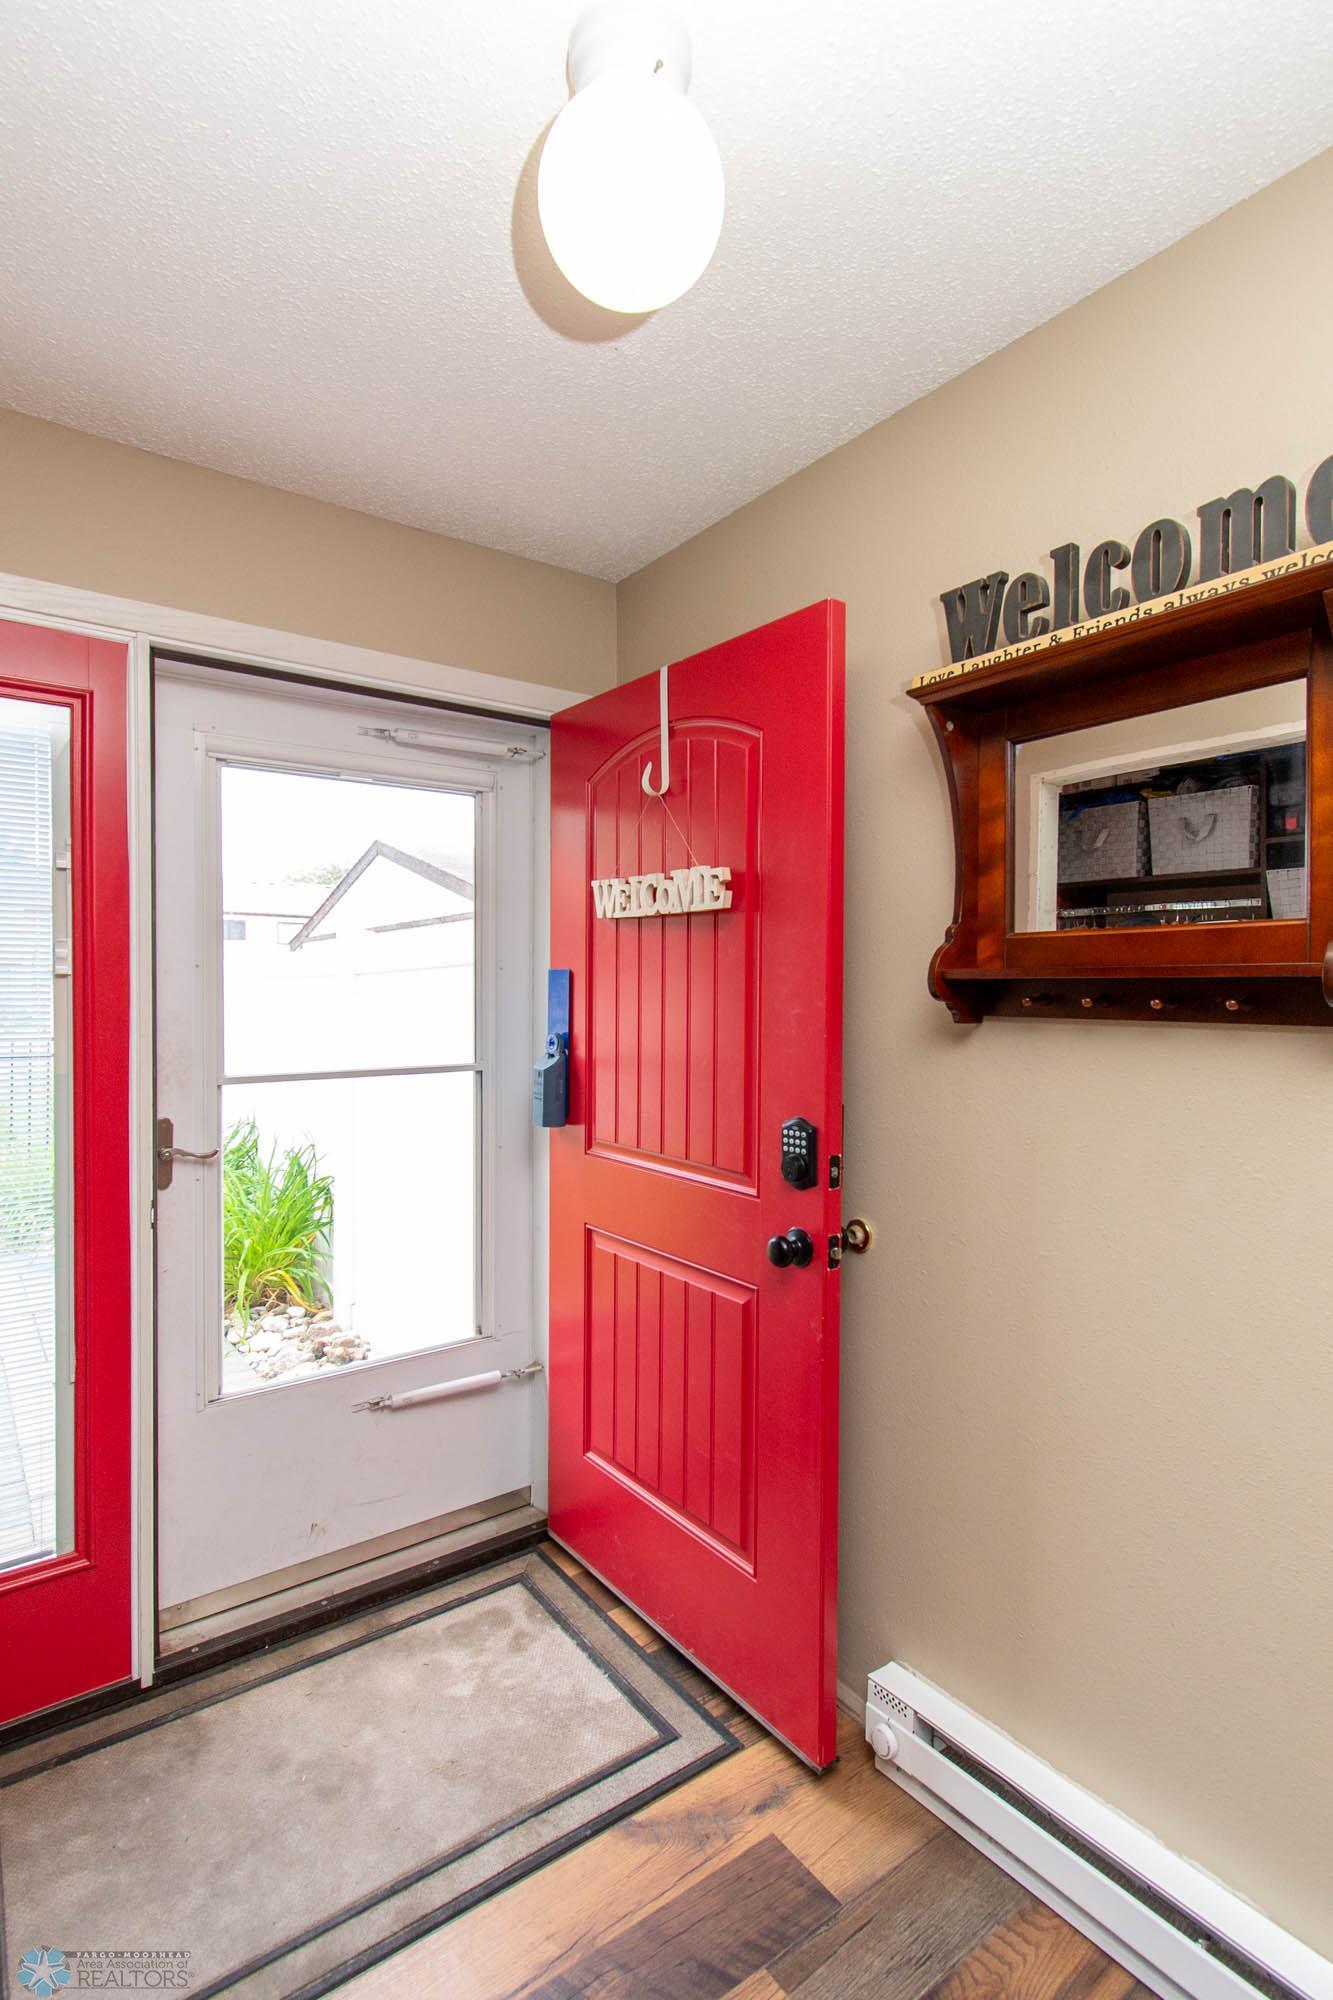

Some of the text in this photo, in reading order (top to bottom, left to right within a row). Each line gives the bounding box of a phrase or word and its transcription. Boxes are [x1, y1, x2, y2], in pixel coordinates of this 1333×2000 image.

[920, 669, 954, 687] Love
[961, 642, 1041, 673] Laughter
[1049, 633, 1064, 647] &
[1073, 607, 1152, 639] Friends
[1163, 578, 1249, 611] always
[591, 865, 733, 919] WELCOME
